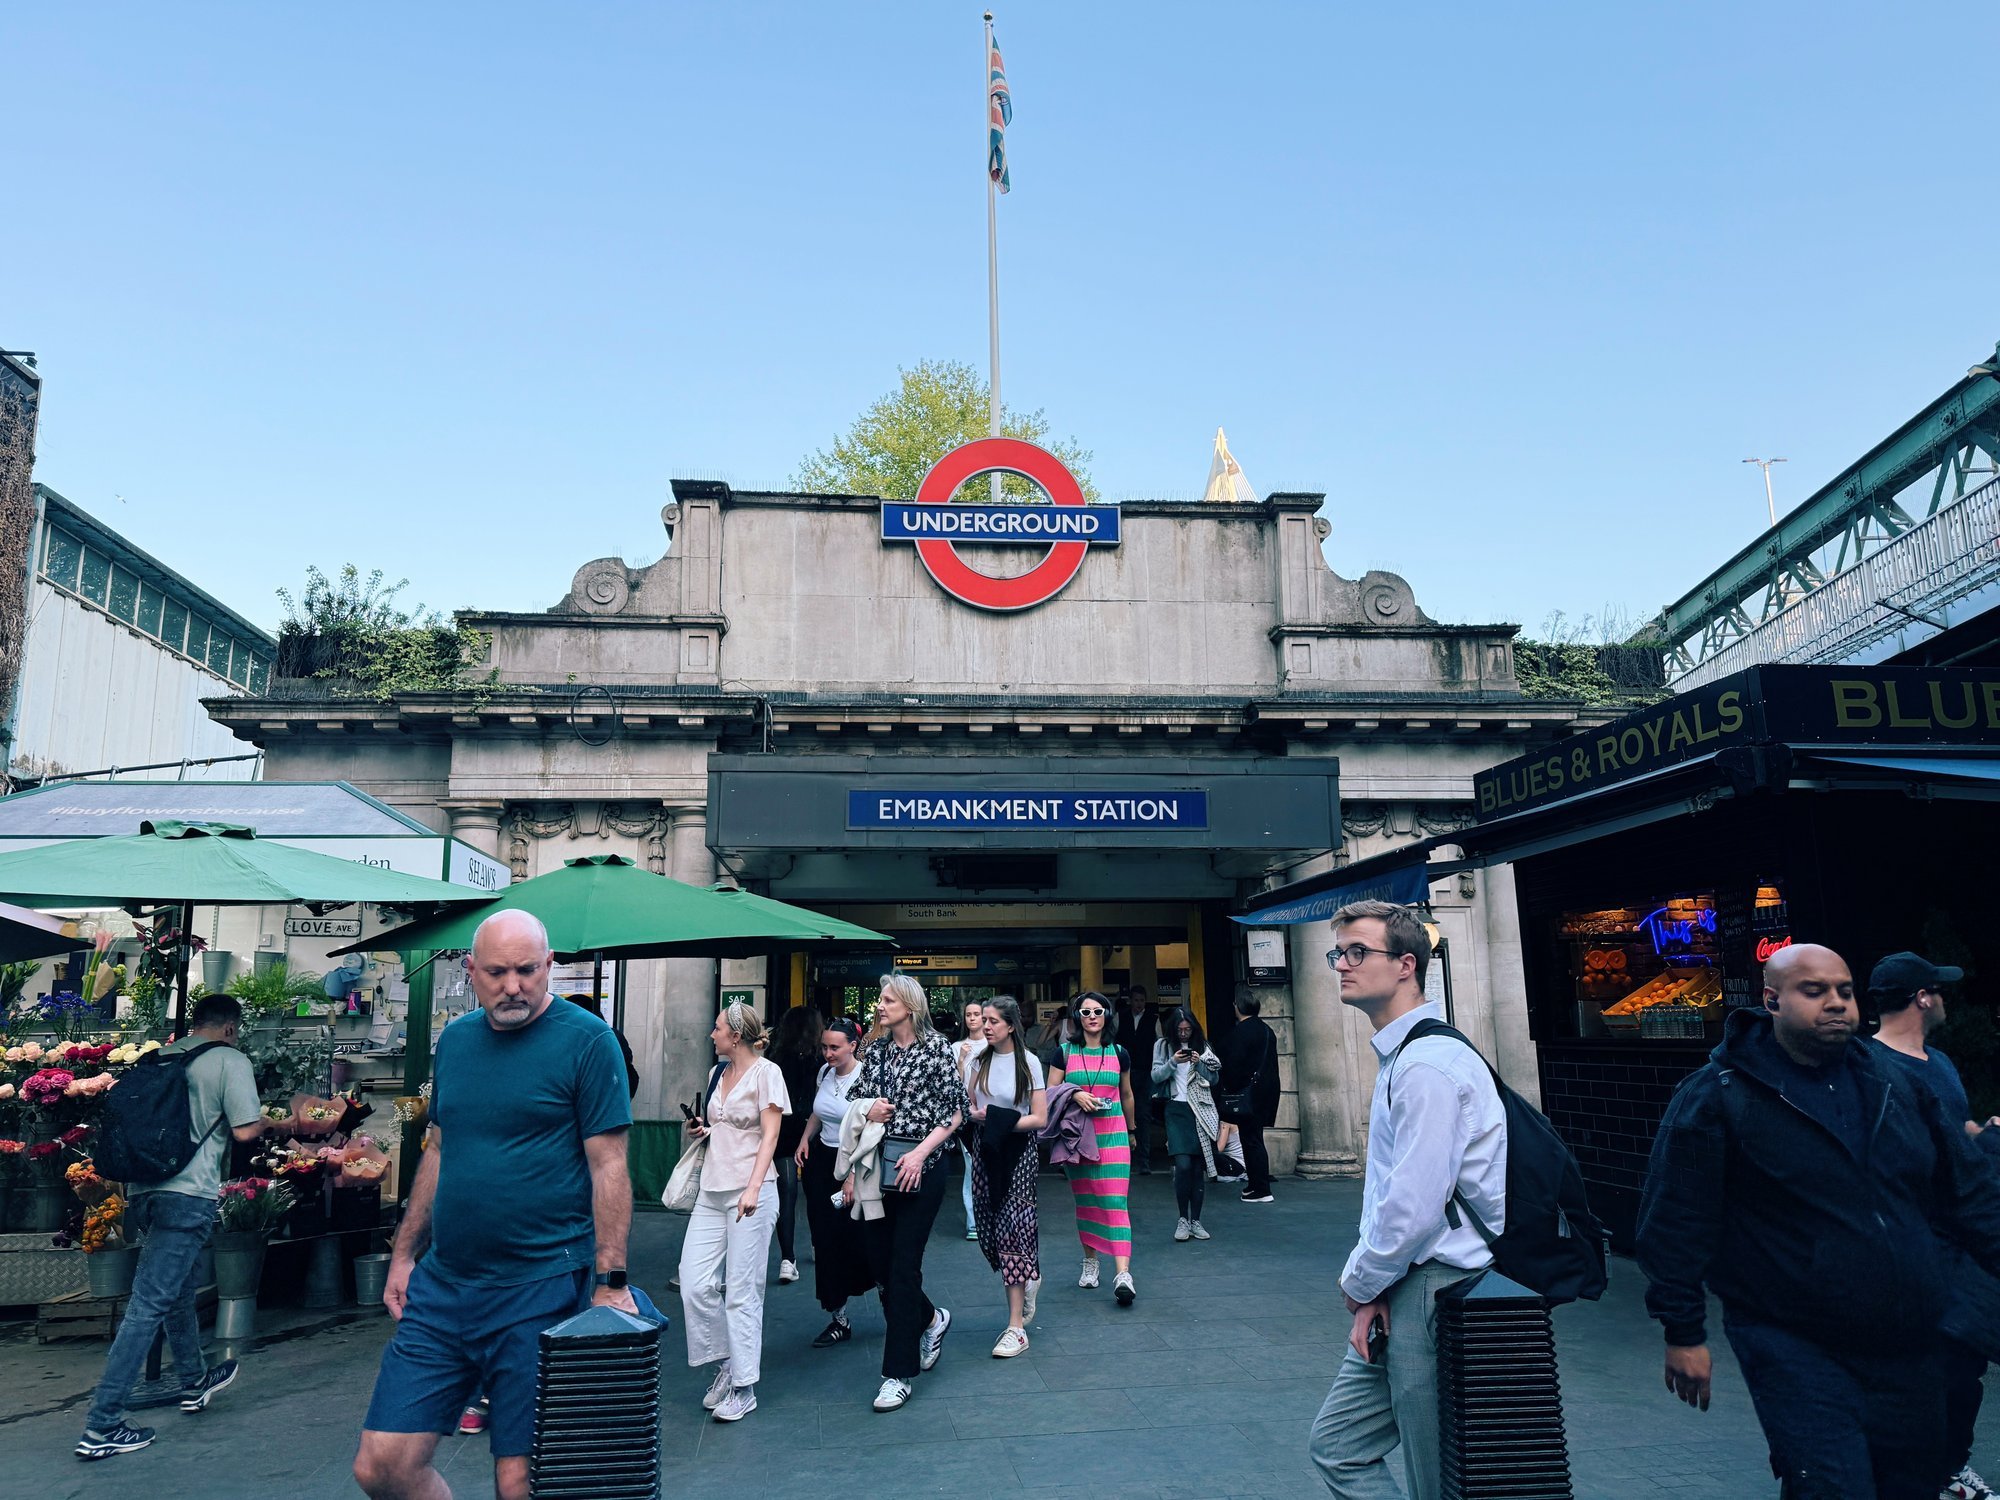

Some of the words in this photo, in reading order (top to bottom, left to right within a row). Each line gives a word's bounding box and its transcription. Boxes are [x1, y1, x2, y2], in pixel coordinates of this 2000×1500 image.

[903, 512, 1099, 534] UNDERGROUND
[1480, 755, 1564, 813] BLUES
[1571, 747, 1592, 783] &
[1600, 691, 1743, 775] ROYALS
[47, 806, 305, 816] #ibuyflowersbecause
[879, 799, 1063, 821] EMBANKMENT
[1073, 799, 1179, 821] STATION
[907, 909, 934, 918] South
[936, 909, 957, 918] Bank
[1311, 896, 1342, 915] COFFEE
[291, 921, 332, 934] LOVE
[335, 924, 355, 932] AVE.
[1638, 907, 1694, 955] This
[1696, 907, 1718, 933] is
